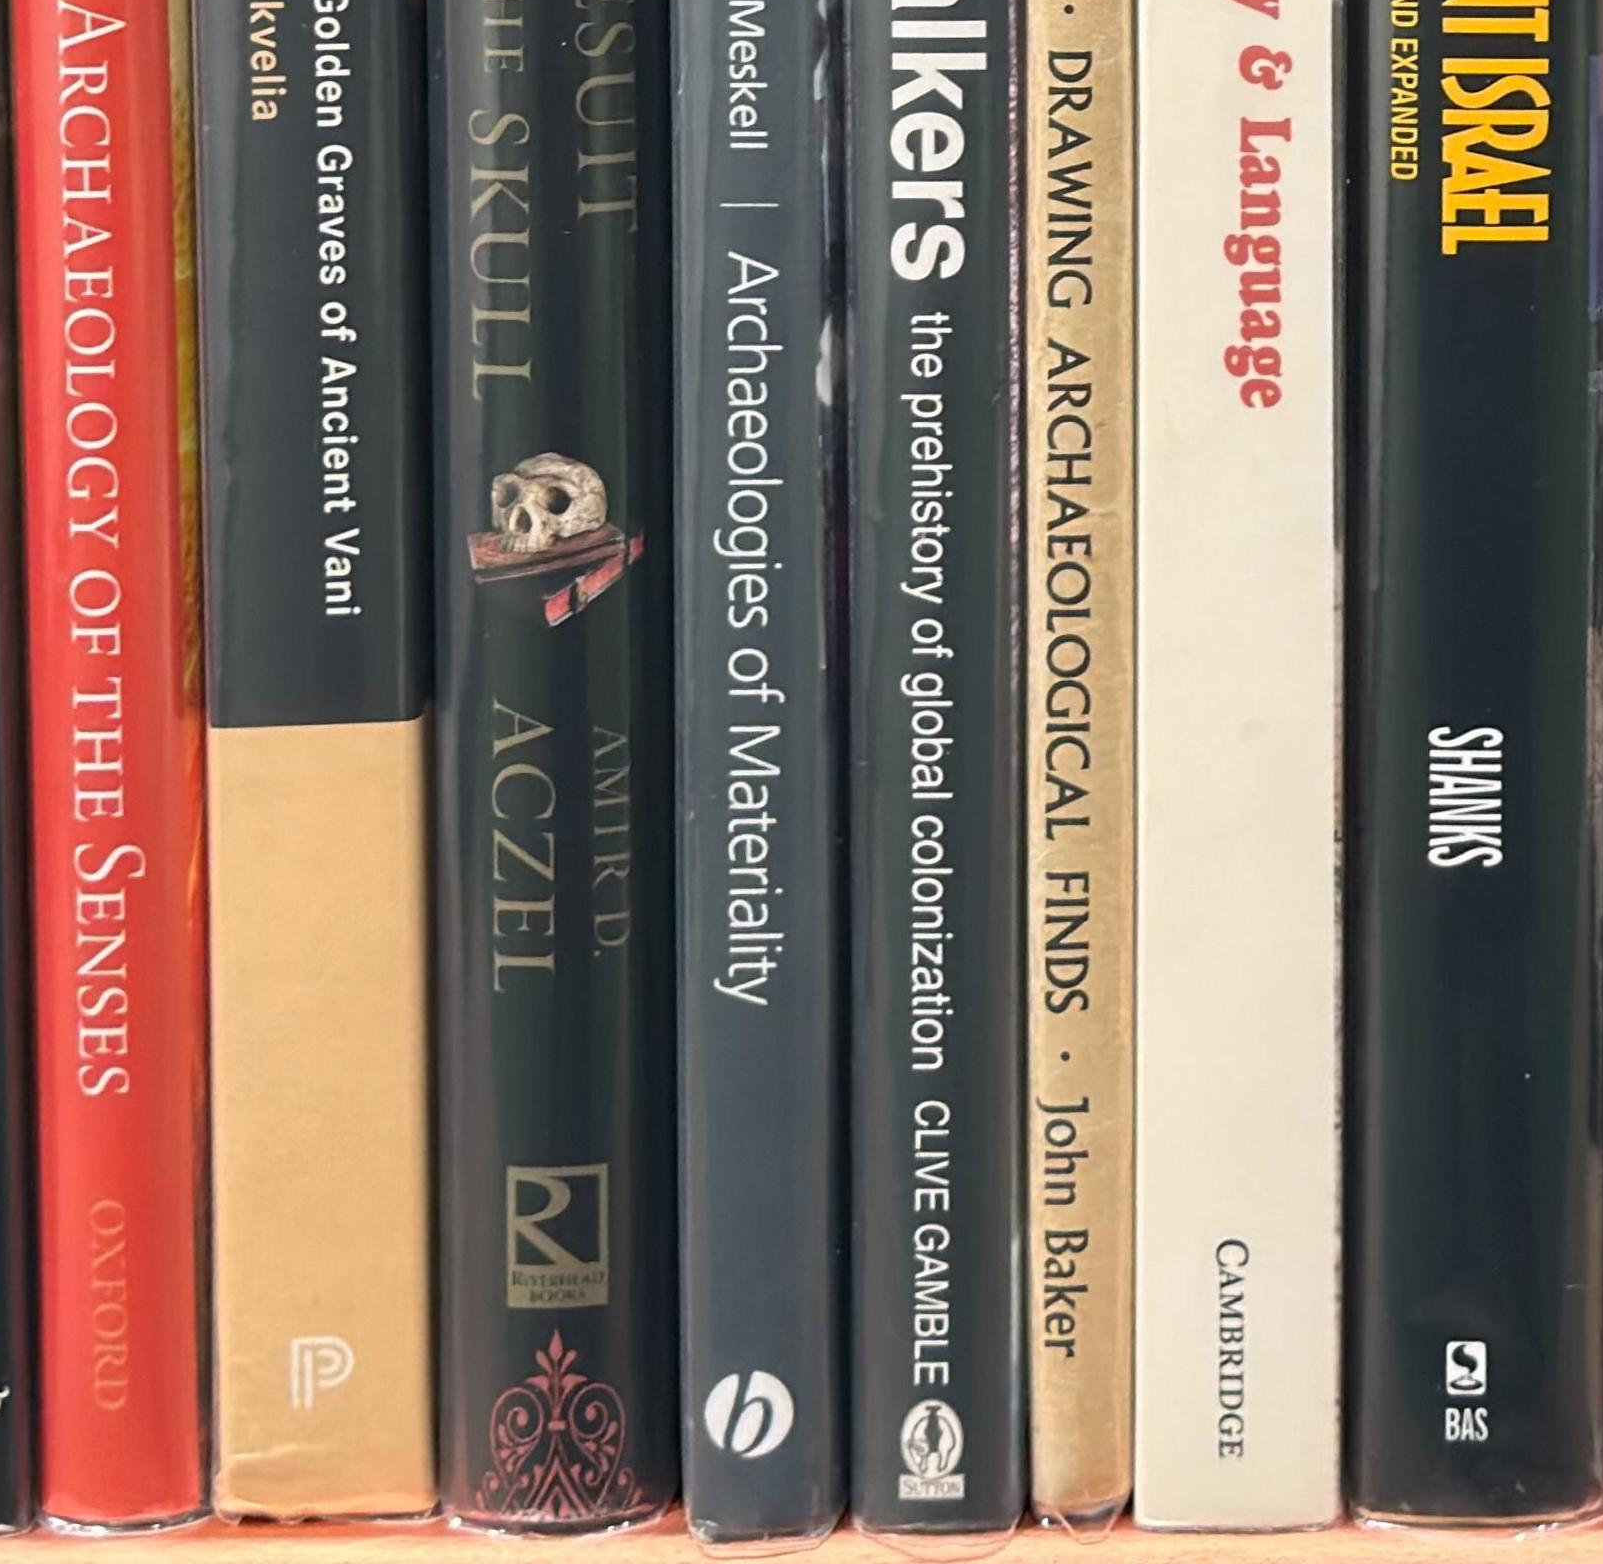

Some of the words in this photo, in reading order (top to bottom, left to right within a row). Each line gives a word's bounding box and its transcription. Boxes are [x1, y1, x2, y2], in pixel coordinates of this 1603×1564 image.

[728, 0, 768, 149] Meskell
[1238, 45, 1293, 91] &
[1390, 38, 1420, 182] EXPANDED
[315, 146, 353, 287] Graves
[1046, 50, 1093, 310] DRAWING
[1441, 57, 1551, 255] ISRAEL
[56, 0, 127, 549] ARCHAEOLOGY
[318, 301, 357, 343] of
[468, 110, 532, 400] SKULL
[1223, 116, 1292, 409] Language
[910, 312, 953, 378] the
[320, 356, 360, 515] Ancient
[714, 251, 783, 628] Archaeologies
[901, 393, 953, 605] prehistory
[69, 571, 121, 657] OF
[323, 529, 363, 617] Vani
[911, 619, 953, 658] of
[1045, 339, 1092, 841] ARCHAEOLOGICAL
[728, 647, 784, 702] of
[901, 671, 953, 800] global
[72, 676, 124, 822] THE
[591, 725, 632, 889] AMIR
[1428, 726, 1503, 868] SHANKS
[490, 699, 556, 993] ACZEL
[715, 725, 784, 1006] Materiality
[75, 843, 146, 1097] SENSES
[593, 909, 631, 957] D.
[911, 814, 954, 1071] colonization
[1044, 870, 1090, 1016] FINDS
[913, 1100, 951, 1212] CLIVE
[1036, 1096, 1090, 1207] John
[90, 1200, 126, 1411] OXFORD
[913, 1223, 951, 1388] GAMBLE
[1043, 1228, 1090, 1359] Baker
[1444, 1407, 1488, 1442] BAS
